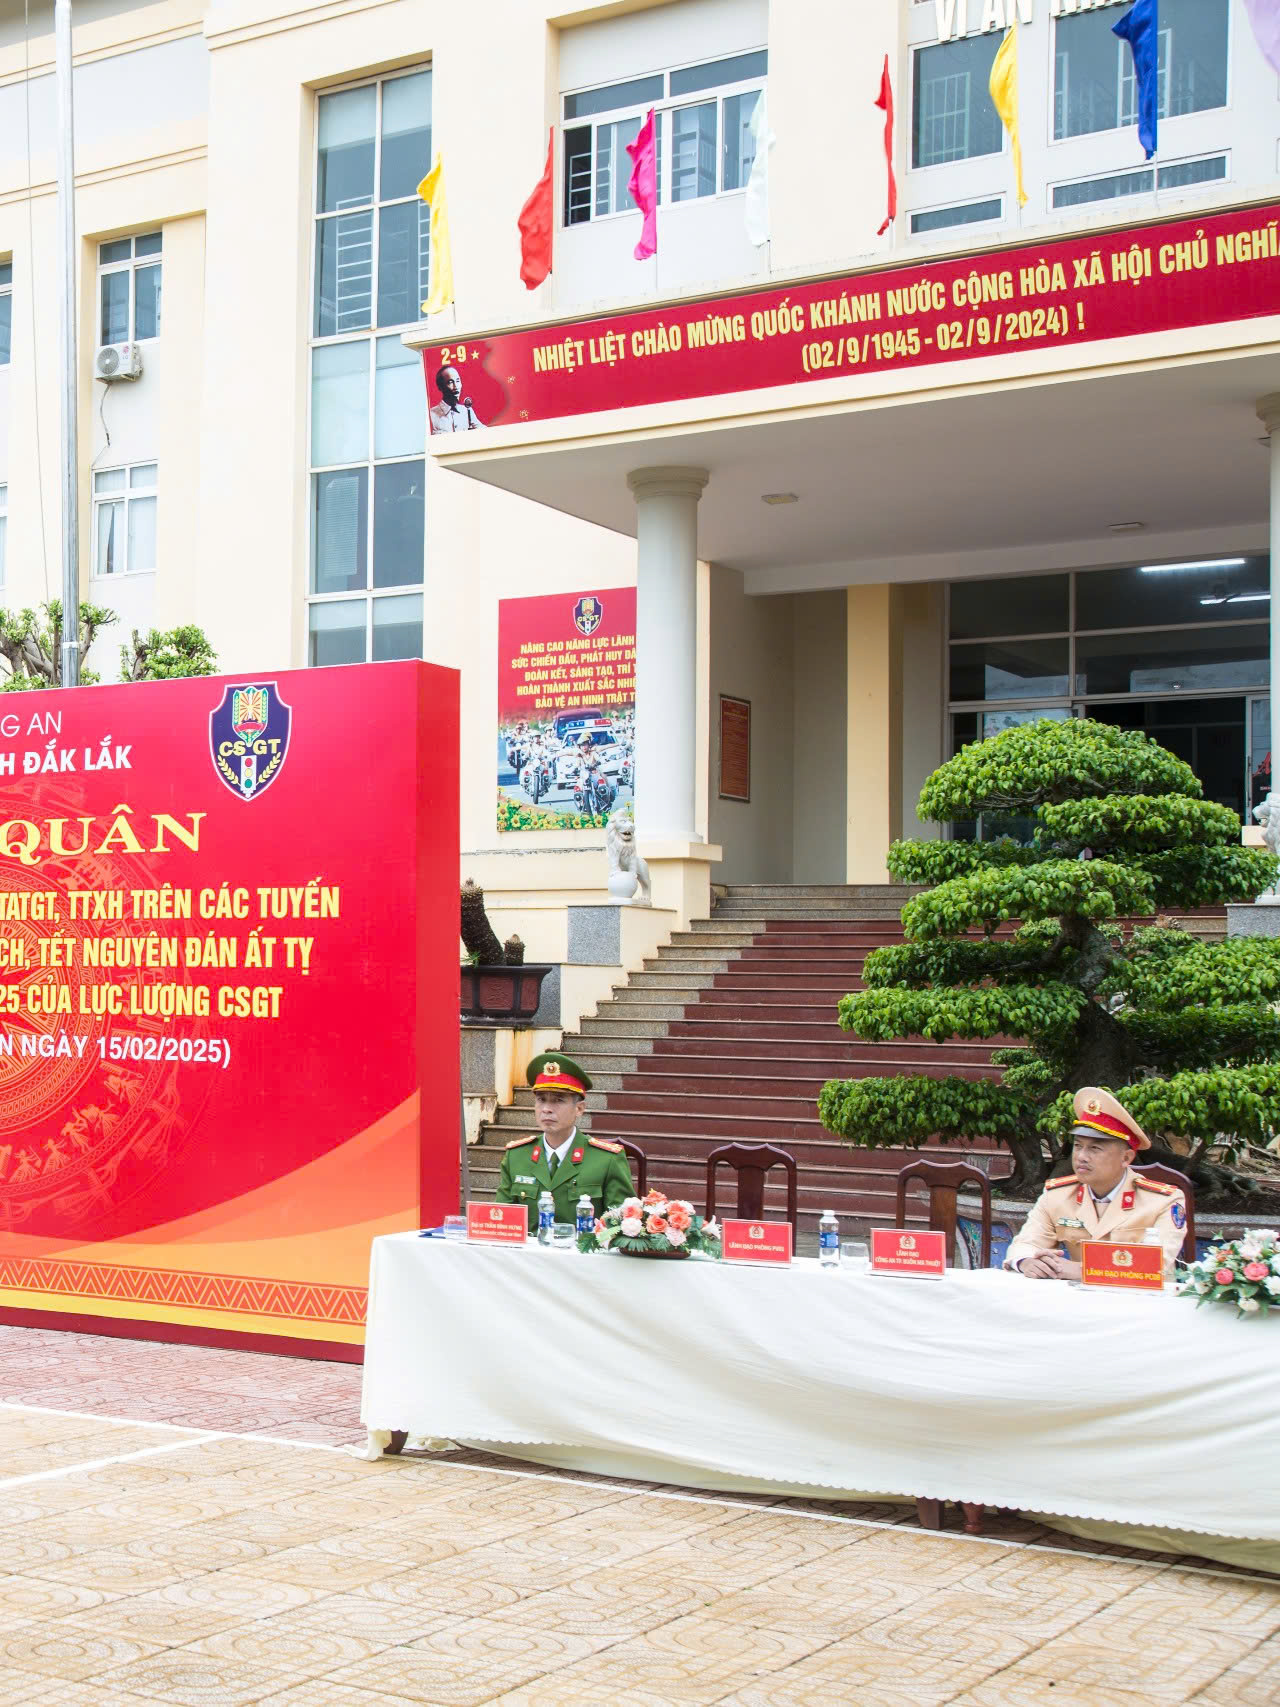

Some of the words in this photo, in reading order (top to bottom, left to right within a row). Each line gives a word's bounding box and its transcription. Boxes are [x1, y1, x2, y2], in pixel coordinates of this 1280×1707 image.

[532, 335, 584, 374] NHIỆT
[590, 331, 625, 370] LIỆT
[632, 323, 682, 357] CHÀO
[688, 314, 745, 352] MỪNG
[751, 297, 805, 340] QUỐC
[810, 286, 881, 329] KHÁNH
[887, 278, 946, 318] NƯỚC
[953, 271, 1013, 311] CỘNG
[1019, 259, 1067, 297] HÒA
[1074, 251, 1105, 288] XÃ
[1111, 244, 1152, 286] HỘI
[1159, 229, 1209, 274] CHỦ
[1216, 220, 1280, 265] NGHĨ
[441, 347, 467, 365] 2-9
[547, 641, 564, 652] CAO
[581, 651, 603, 663] PHÁT
[606, 650, 623, 661] HUY
[570, 666, 594, 678] SÁNG
[543, 682, 571, 694] THÀNH
[568, 695, 580, 706] AN
[582, 694, 604, 705] NINH
[26, 711, 62, 735] AN
[23, 738, 76, 774] ĐẮK
[84, 734, 132, 770] LẮK
[68, 889, 124, 921] TTXH
[131, 882, 192, 920] TRÊN
[200, 881, 250, 919] CÁC
[257, 877, 340, 918] TUYẾN
[38, 929, 77, 968] TẾT
[83, 931, 178, 968] NGUYÊN
[185, 931, 237, 968] ĐÁN
[244, 926, 277, 968] ẤT
[284, 936, 314, 976] TỴ
[27, 974, 72, 1014] CỦA
[80, 984, 123, 1021] LỰC
[130, 982, 210, 1023] LƯỢNG
[218, 986, 283, 1018] CSGT
[21, 1029, 88, 1058] NGÀY
[96, 1036, 231, 1069] 15/02/2025)
